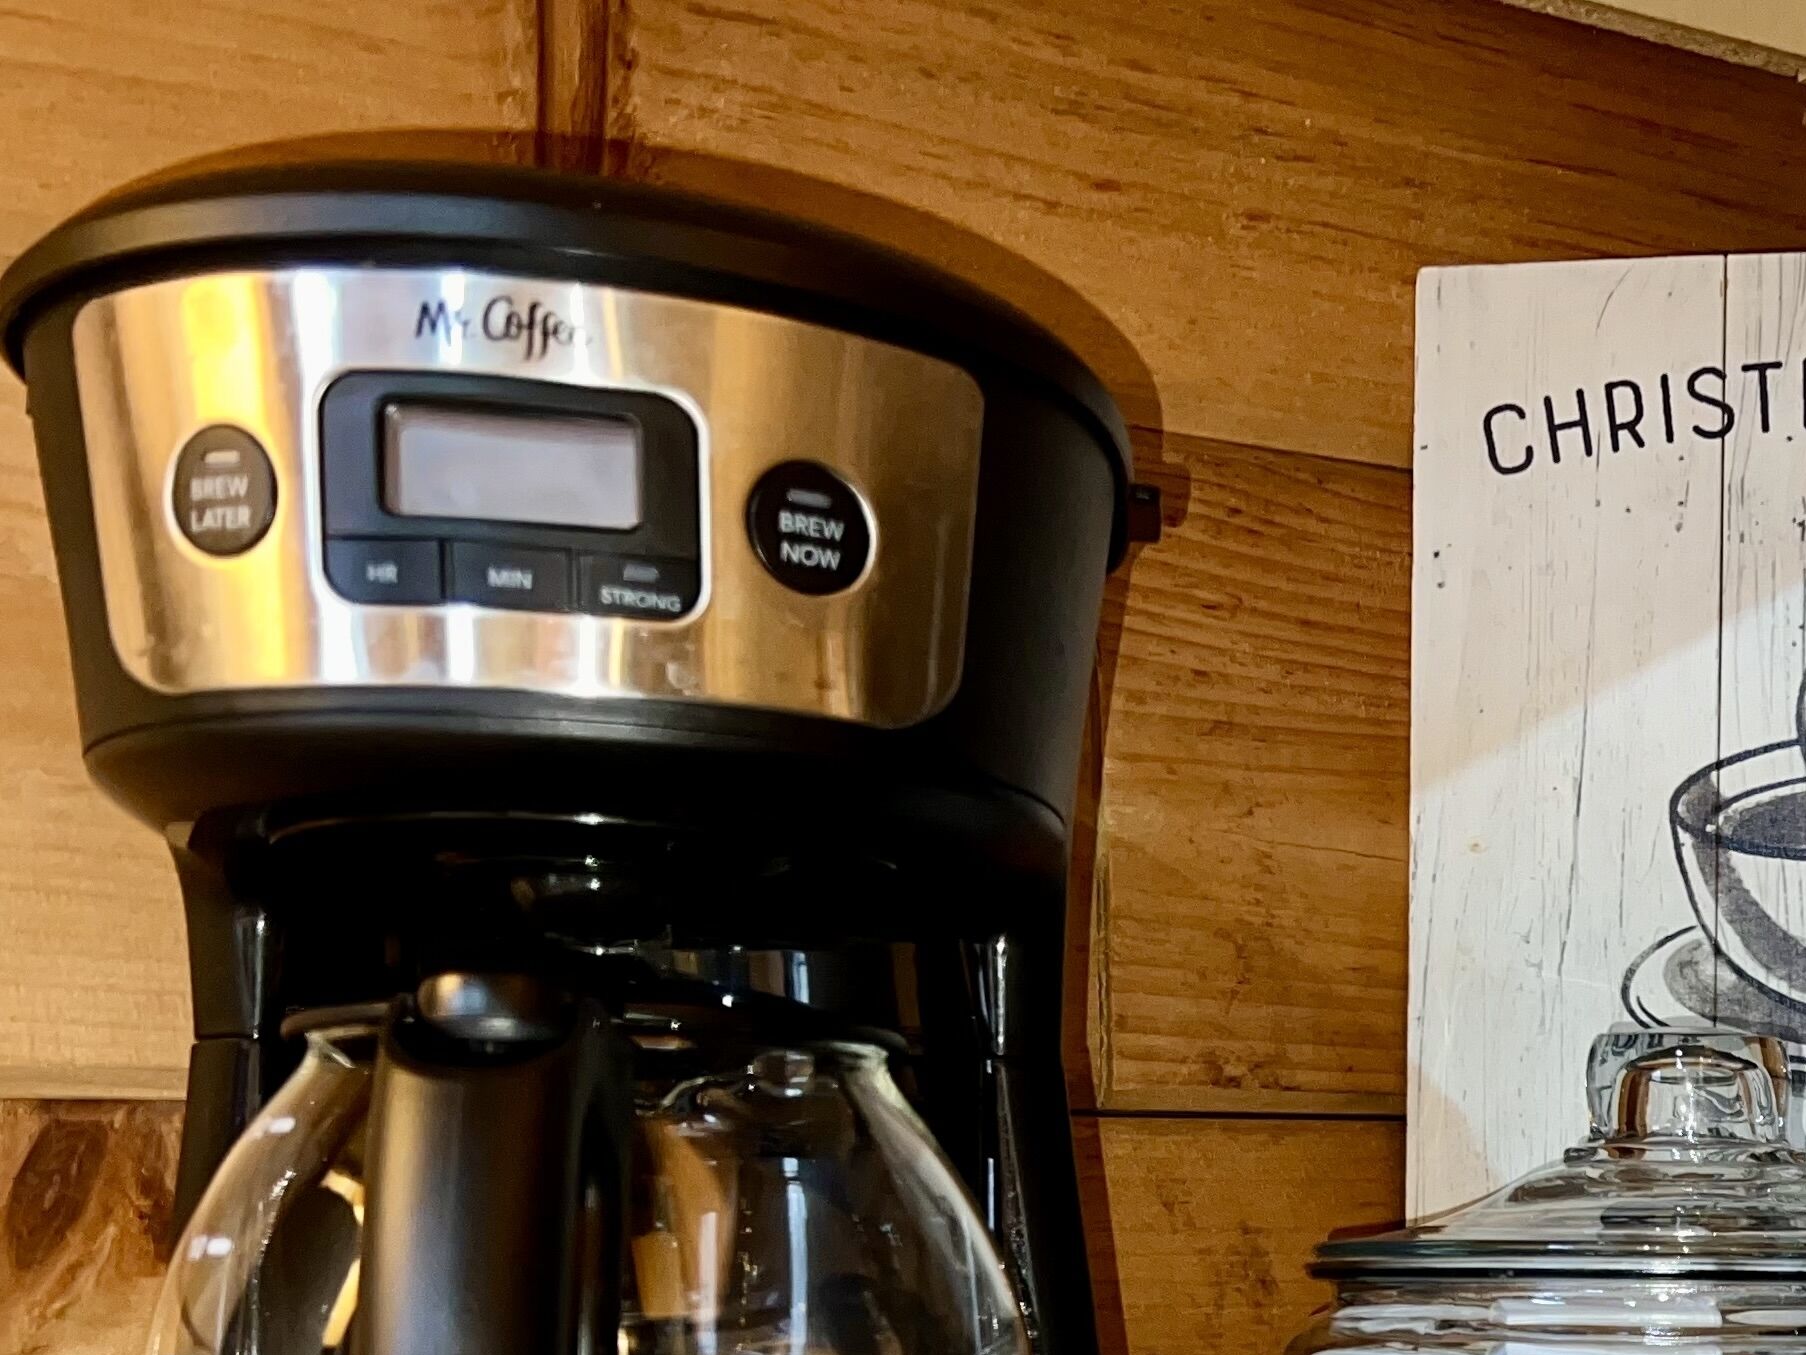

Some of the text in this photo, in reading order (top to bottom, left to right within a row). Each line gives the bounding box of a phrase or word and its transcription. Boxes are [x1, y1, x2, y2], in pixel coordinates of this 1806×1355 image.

[482, 295, 594, 361] Coffe
[190, 474, 249, 501] BREW
[190, 504, 251, 533] LATER
[778, 509, 845, 542] BREW
[780, 540, 841, 571] NOW
[366, 560, 399, 584] HR
[486, 565, 534, 590] MIN
[600, 585, 682, 613] STRONG
